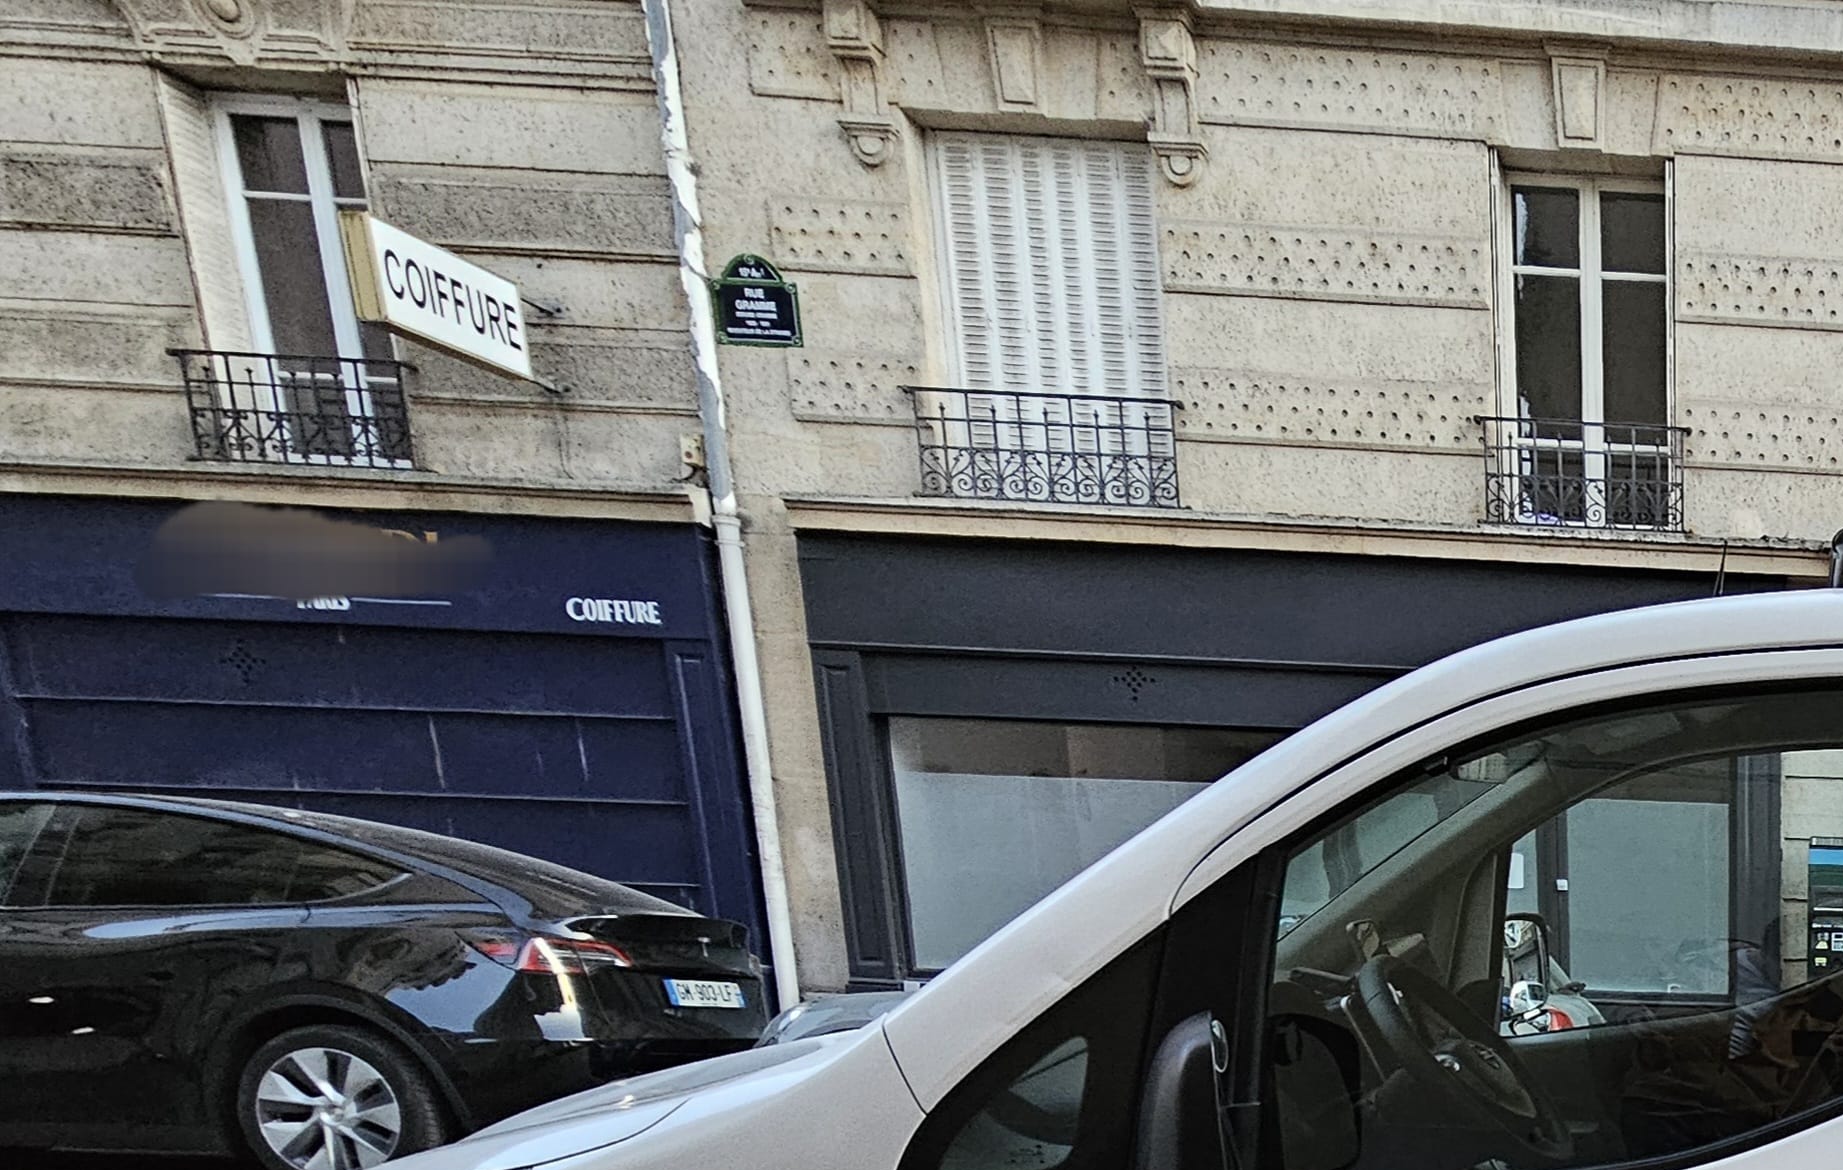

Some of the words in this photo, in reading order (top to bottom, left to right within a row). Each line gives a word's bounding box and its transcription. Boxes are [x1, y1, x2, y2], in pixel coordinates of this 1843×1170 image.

[384, 248, 522, 351] COIFFURE
[743, 287, 765, 299] RUE
[566, 597, 662, 624] COIFFURE
